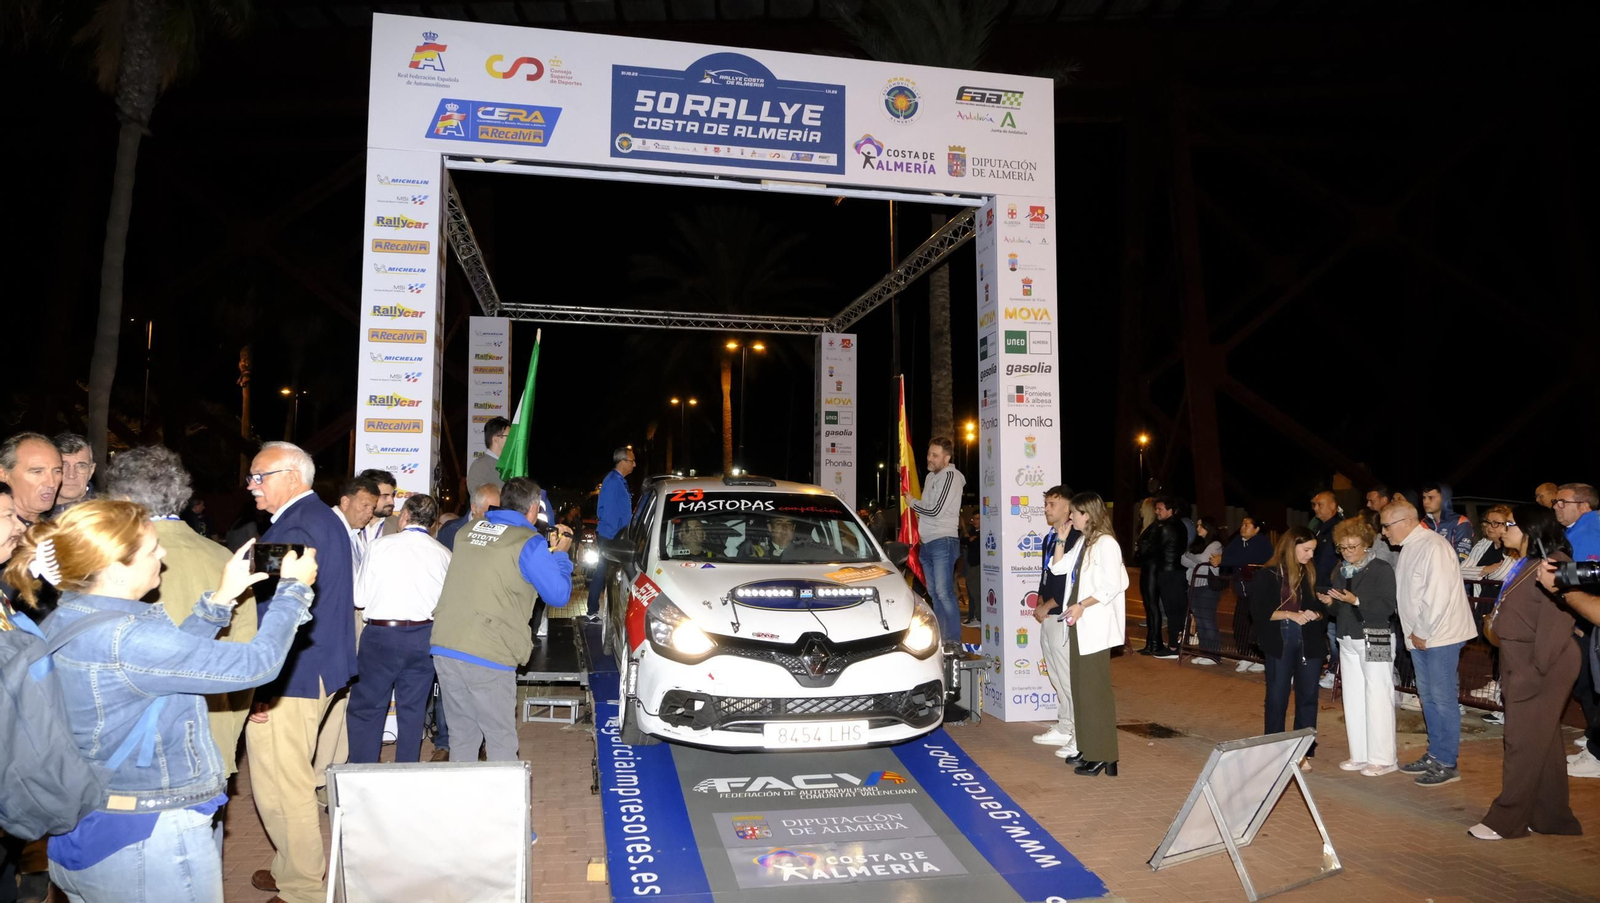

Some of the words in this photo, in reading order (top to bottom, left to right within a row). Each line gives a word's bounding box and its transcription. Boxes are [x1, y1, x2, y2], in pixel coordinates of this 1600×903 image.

[477, 106, 545, 123] CERA
[634, 89, 679, 114] 50
[683, 94, 825, 127] RALLYE
[490, 128, 533, 141] Recalvi
[633, 117, 699, 134] COSTA
[703, 122, 729, 136] DE
[733, 125, 822, 143] ALMERÍA
[886, 149, 919, 160] COSTA
[922, 152, 935, 161] DE
[876, 160, 936, 175] ALMERÍA
[971, 156, 1037, 171] DIPUTACIÓN
[972, 167, 987, 178] DE
[988, 169, 1035, 182] ALMERÍA
[384, 242, 418, 251] Recalvi
[1004, 307, 1051, 321] MOYA
[380, 331, 415, 341] Recalvi
[1006, 338, 1025, 346] UNED
[1006, 362, 1052, 376] gasolia
[825, 397, 852, 406] MOYA
[376, 421, 412, 431] Recalvi
[1008, 413, 1053, 428] Phonika
[825, 428, 853, 437] gasolia
[825, 458, 852, 468] Phonika
[670, 488, 704, 502] 23
[678, 500, 776, 512] MASTOPAS
[468, 532, 499, 542] FOTO/TV
[470, 539, 487, 547] 2025
[1013, 692, 1057, 711] argar
[778, 726, 821, 743] 8454
[830, 725, 861, 742] LHS
[719, 790, 781, 799] FEDERACIÓN
[783, 789, 797, 797] DE
[799, 786, 879, 797] AUTOMOVILISMO
[800, 790, 857, 800] COMUNITAT
[860, 787, 918, 798] VALENCIANA
[924, 744, 1062, 868] www.garciaimpr
[781, 812, 904, 827] DIPUTACIÓN
[787, 826, 816, 837] DE
[821, 820, 909, 836] ALMERÍA
[826, 852, 896, 865] COSTA
[899, 851, 928, 861] DE
[812, 858, 941, 880] ALMERÍA
